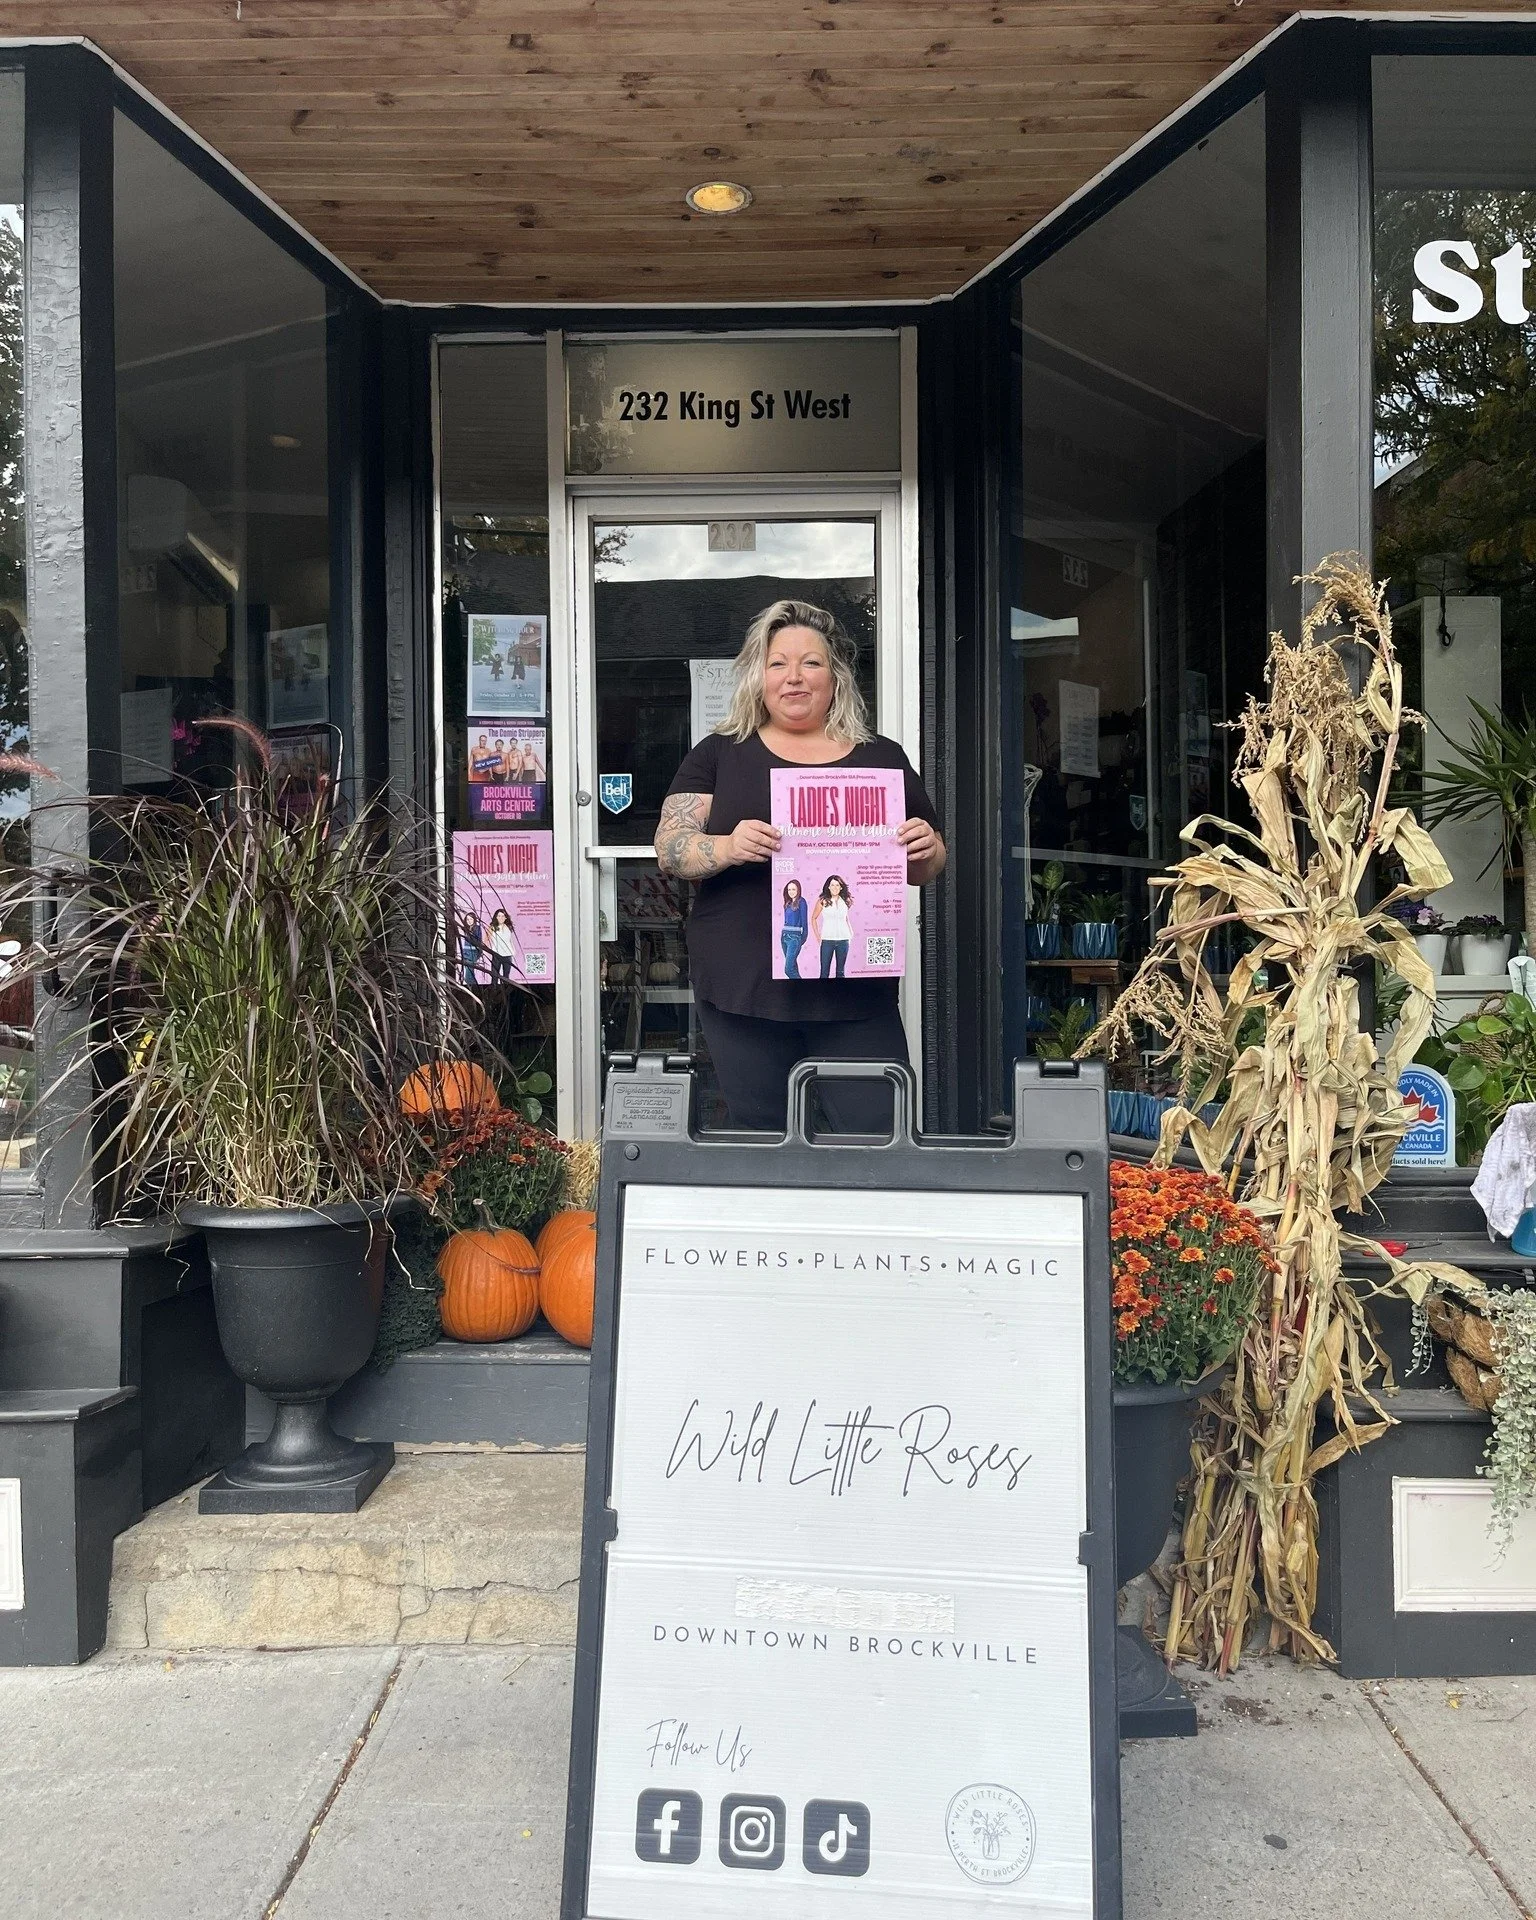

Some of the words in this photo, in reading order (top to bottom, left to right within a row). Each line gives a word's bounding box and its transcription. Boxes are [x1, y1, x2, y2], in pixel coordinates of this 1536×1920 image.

[1412, 239, 1532, 325] St
[619, 391, 669, 421] 232
[679, 391, 741, 428] King
[750, 390, 775, 420] St
[784, 389, 852, 419] West
[710, 522, 754, 550] 232
[707, 668, 738, 678] STO
[488, 729, 498, 737] The
[499, 729, 517, 737] Comic
[518, 729, 545, 738] Strippers
[483, 787, 532, 798] BROCKVILLE
[606, 783, 627, 796] Bell
[480, 800, 502, 812] ARTS
[504, 800, 535, 811] CENTRE
[790, 787, 840, 828] LADIES
[845, 786, 887, 827] NIGHT
[826, 823, 857, 838] Girls
[467, 845, 503, 874] LADIES
[508, 844, 538, 873] NIGHT
[1414, 1078, 1432, 1091] MADE
[1430, 1088, 1439, 1097] IN
[1403, 1134, 1441, 1142] CKVILLE
[1412, 1157, 1427, 1165] sold
[1427, 1157, 1447, 1165] here!
[645, 1248, 789, 1269] FLOWERS
[814, 1253, 932, 1273] PLANTS
[957, 1257, 1059, 1277] MAGIC
[665, 1399, 779, 1483] Wild
[789, 1399, 894, 1497] Little
[899, 1404, 1033, 1498] Roses
[653, 1625, 829, 1651] DOWNTOWN
[849, 1636, 1039, 1664] BROCKVILLE
[646, 1718, 709, 1769] Follow
[715, 1724, 753, 1774] Us
[953, 1799, 969, 1820] WILD
[971, 1790, 1004, 1801] LITTLE
[1006, 1798, 1029, 1826] ROSES
[958, 1851, 979, 1872] PERTH
[981, 1868, 990, 1877] ST
[993, 1848, 1029, 1877] BROCKVILLE
